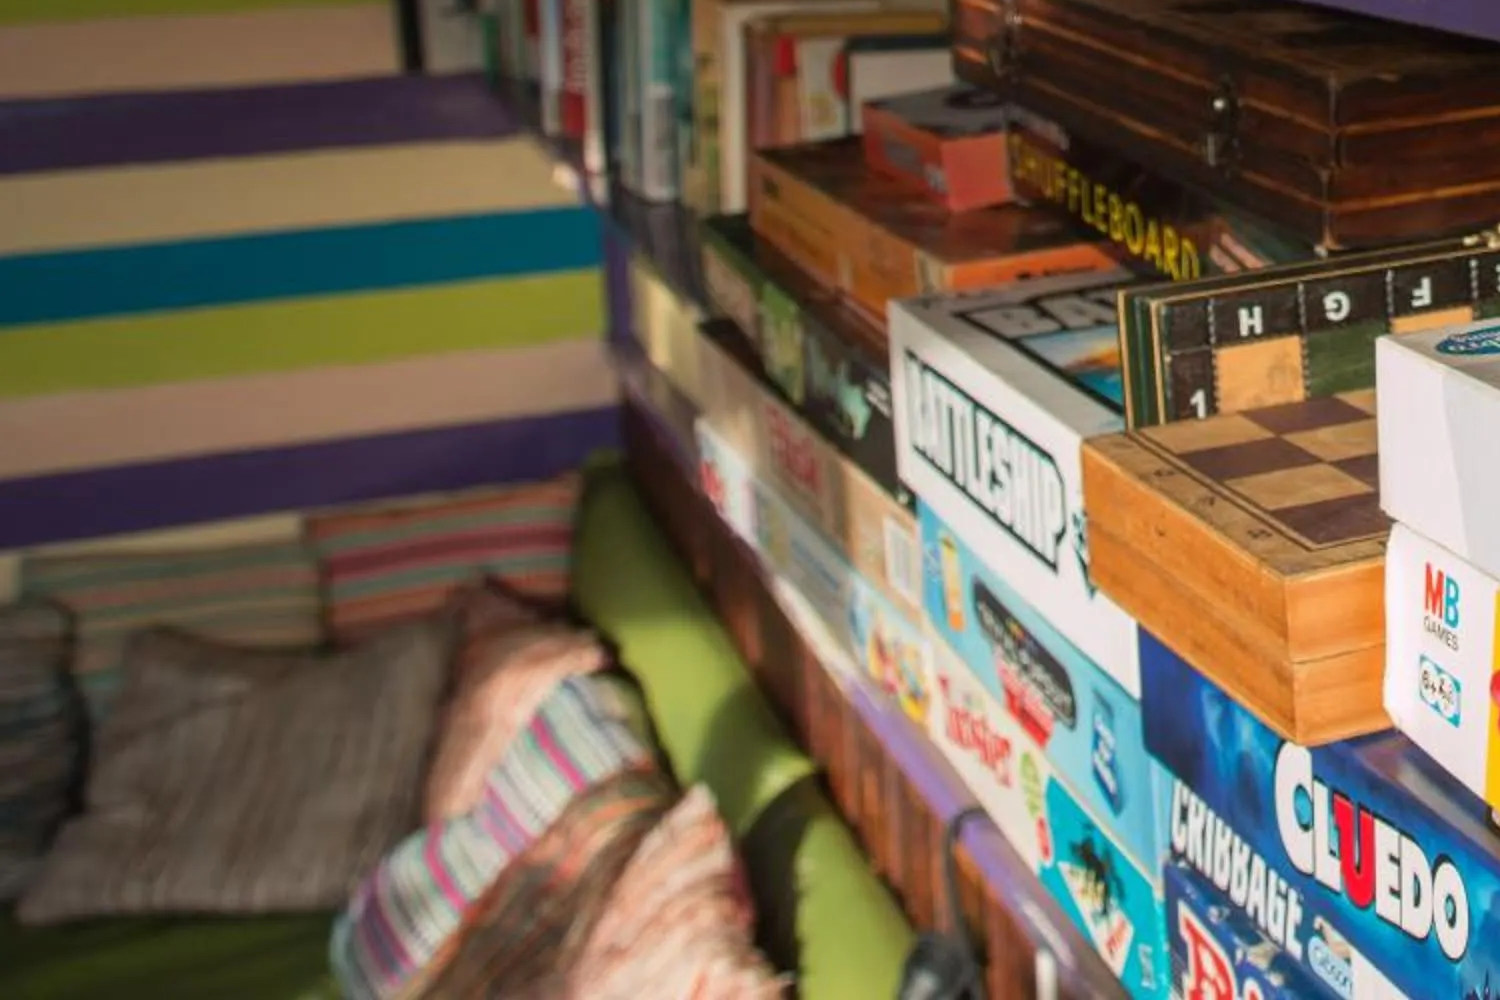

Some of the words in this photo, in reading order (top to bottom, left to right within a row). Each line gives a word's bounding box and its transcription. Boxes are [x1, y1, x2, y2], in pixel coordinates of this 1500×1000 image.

[1324, 290, 1352, 322] G
[1411, 277, 1432, 308] F
[1238, 305, 1264, 337] H
[1188, 389, 1207, 420] 1
[1424, 561, 1460, 629] MB
[1423, 615, 1459, 651] GAMES
[1275, 742, 1469, 962] CLUEDO
[1170, 780, 1304, 962] CRIBBAGE
